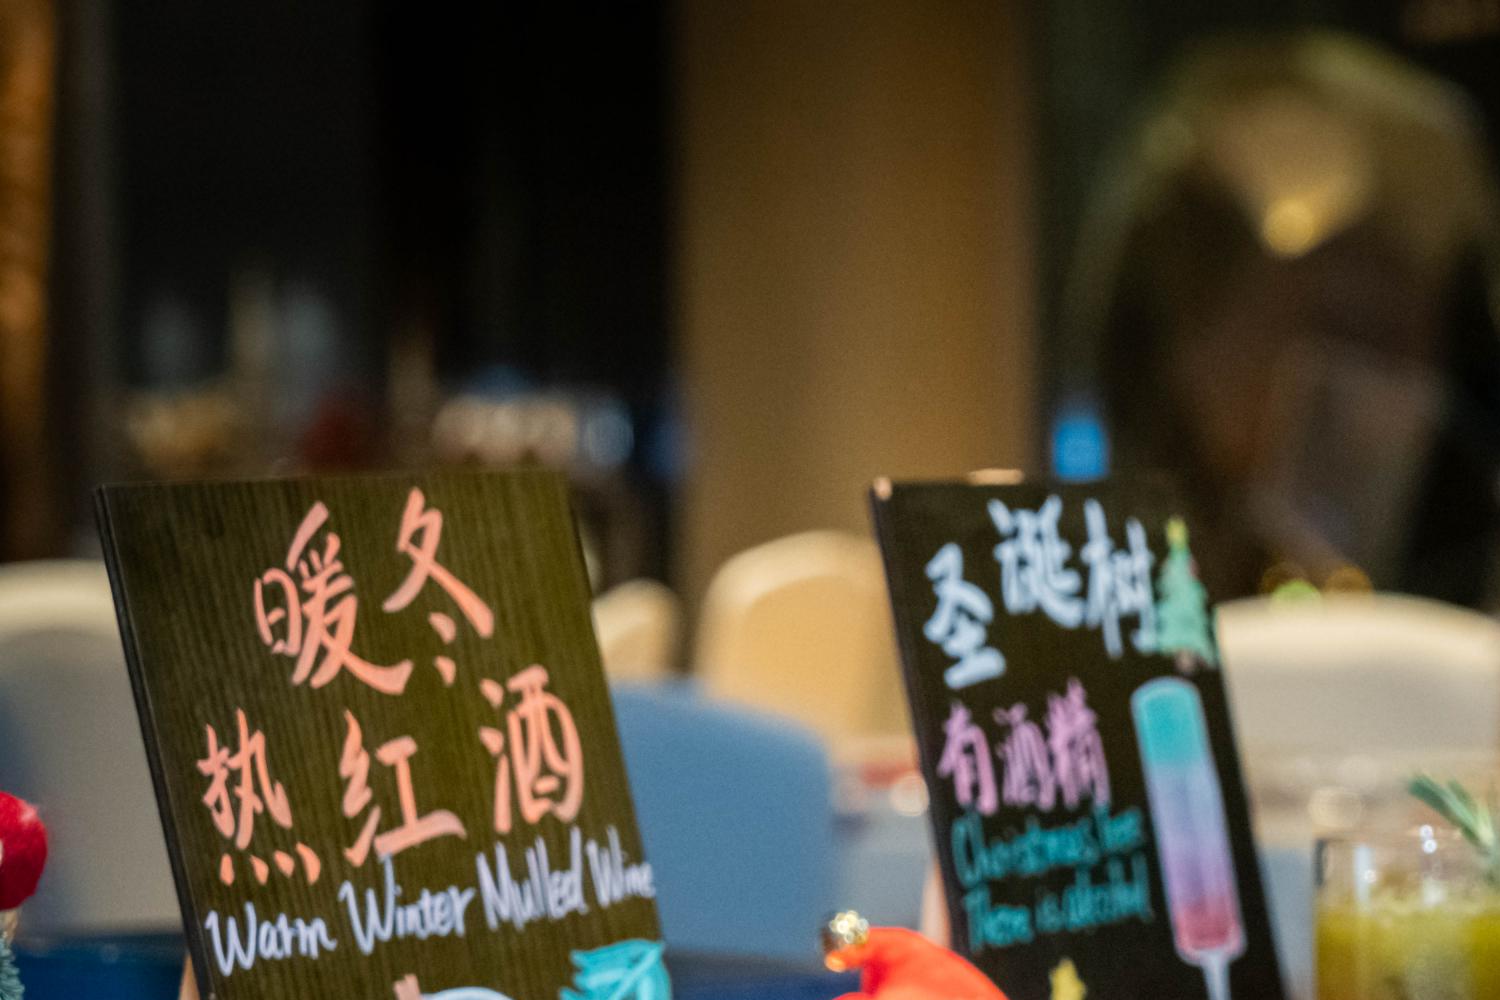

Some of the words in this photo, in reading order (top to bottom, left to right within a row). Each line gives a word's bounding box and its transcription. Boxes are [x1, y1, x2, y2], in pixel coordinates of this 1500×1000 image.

[253, 486, 495, 696] 暖冬
[923, 494, 1158, 690] 圣诞树
[196, 663, 586, 887] 热红酒
[205, 902, 338, 977] Warm
[338, 852, 477, 956] Winter
[475, 825, 588, 932] Mulled
[586, 824, 658, 909] Wine
